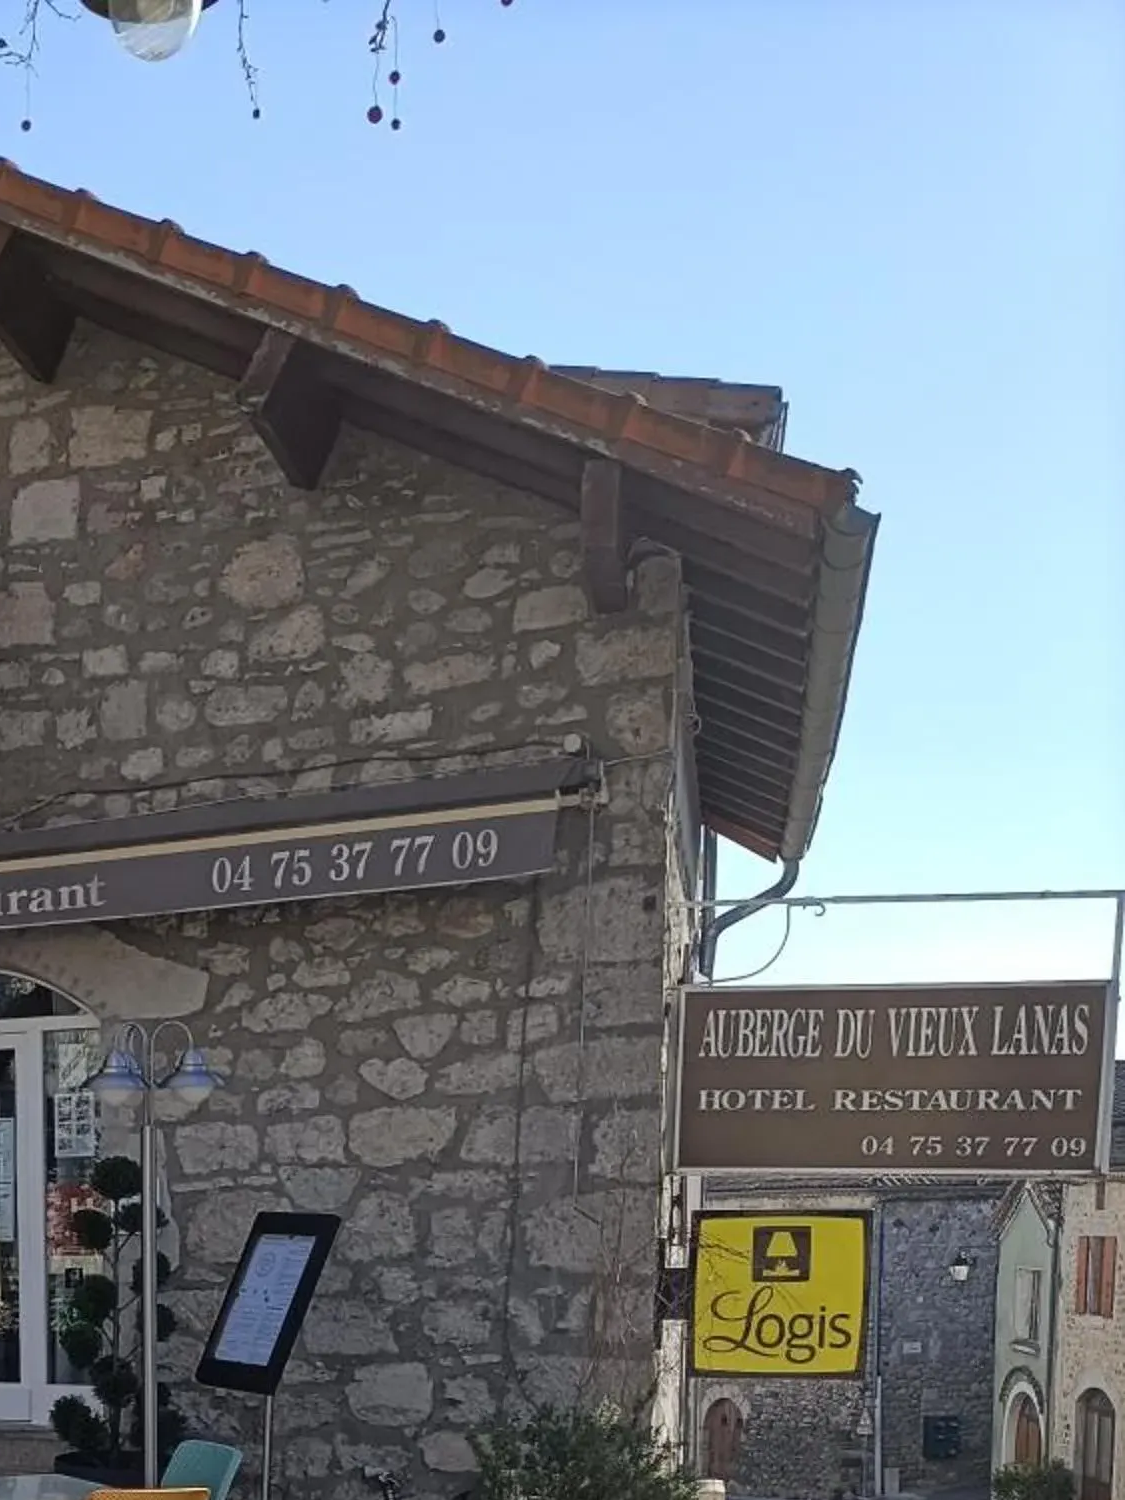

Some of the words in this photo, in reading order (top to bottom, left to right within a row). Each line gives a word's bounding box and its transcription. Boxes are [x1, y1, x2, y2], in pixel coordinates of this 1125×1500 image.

[211, 855, 254, 893] 04
[270, 849, 312, 890] 75
[328, 842, 373, 882] 37
[389, 834, 436, 877] 77
[451, 828, 499, 870] 09
[698, 1008, 824, 1059] AUBERGE
[834, 1008, 876, 1059] DU
[888, 1005, 979, 1058] VIEUX
[990, 1004, 1090, 1057] LANAS
[699, 1088, 816, 1112] HOTEL
[830, 1087, 1083, 1112] RESTAURANT
[861, 1135, 895, 1156] 04
[909, 1135, 943, 1156] 75
[955, 1136, 990, 1156] 37
[1004, 1136, 1037, 1157] 77
[1050, 1136, 1087, 1157] 09
[702, 1284, 852, 1365] Logis
